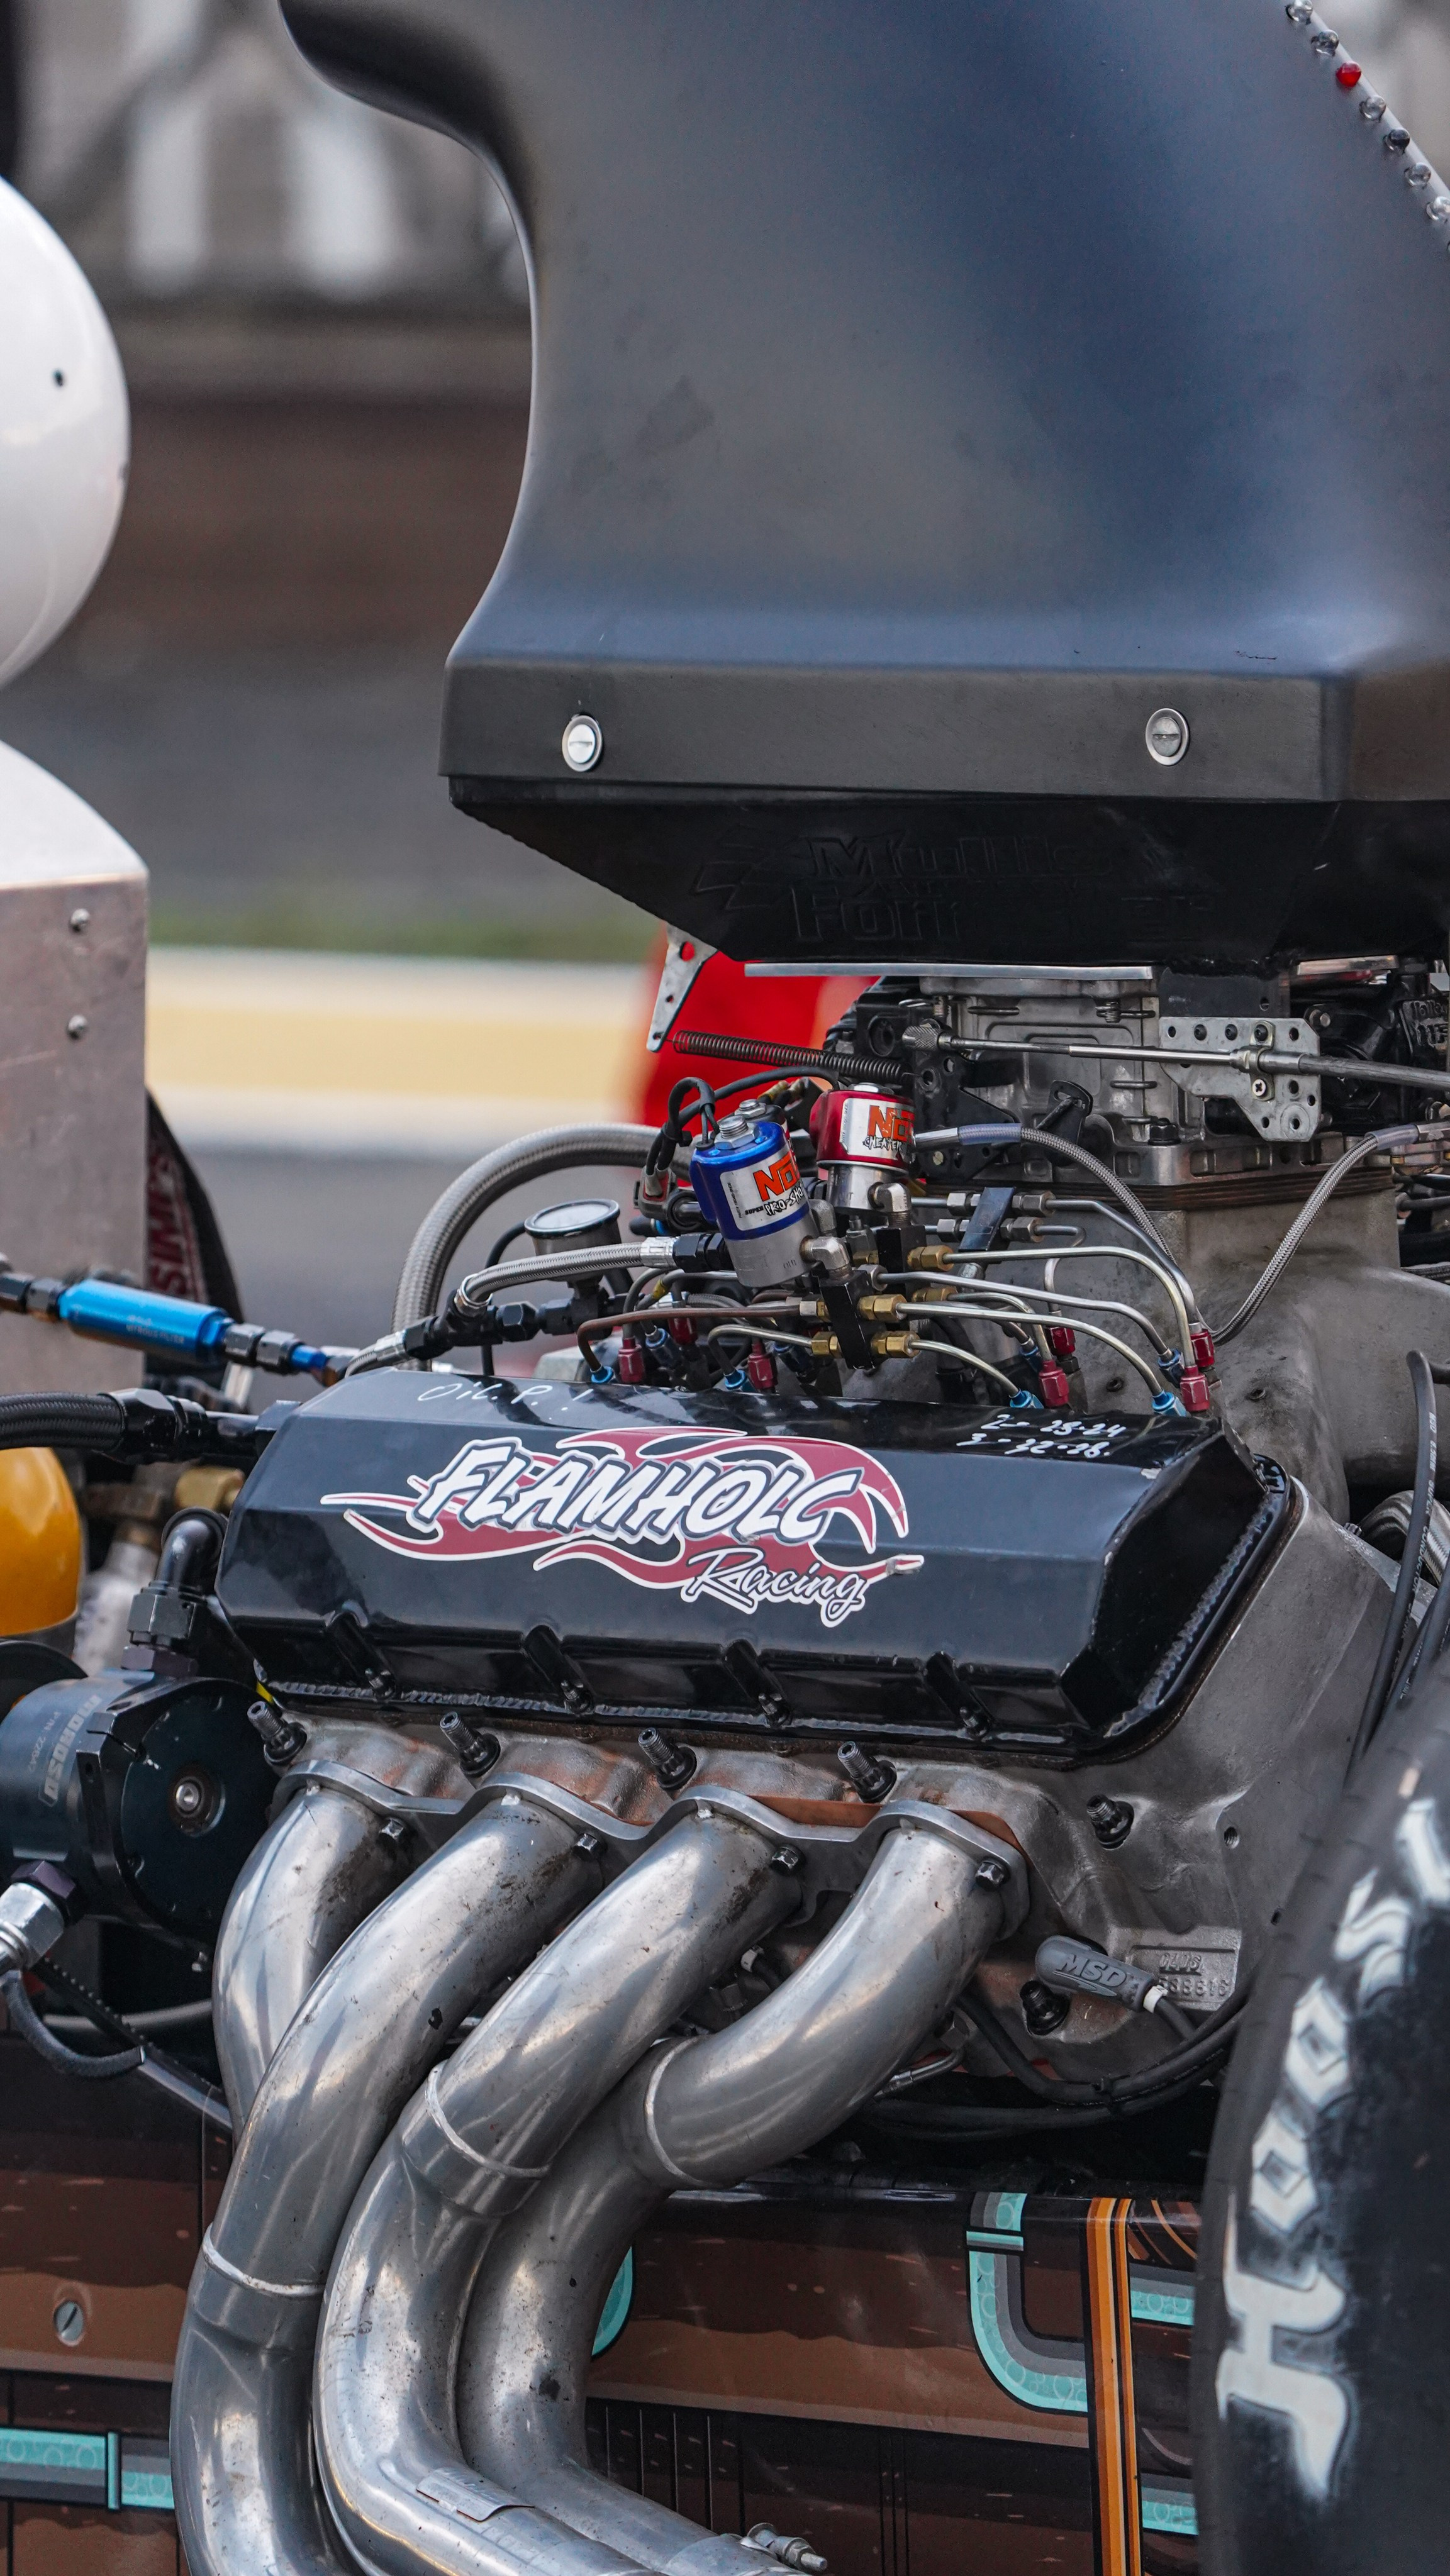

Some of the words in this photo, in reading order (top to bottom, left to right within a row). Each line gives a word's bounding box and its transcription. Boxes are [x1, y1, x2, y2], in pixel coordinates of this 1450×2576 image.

[744, 1206, 764, 1215] SUPER
[408, 1436, 866, 1545] FLAMHOLC
[681, 1546, 871, 1628] Racing
[1411, 1525, 1429, 1594] CONDUCTOR
[1055, 1953, 1127, 1987] MSD
